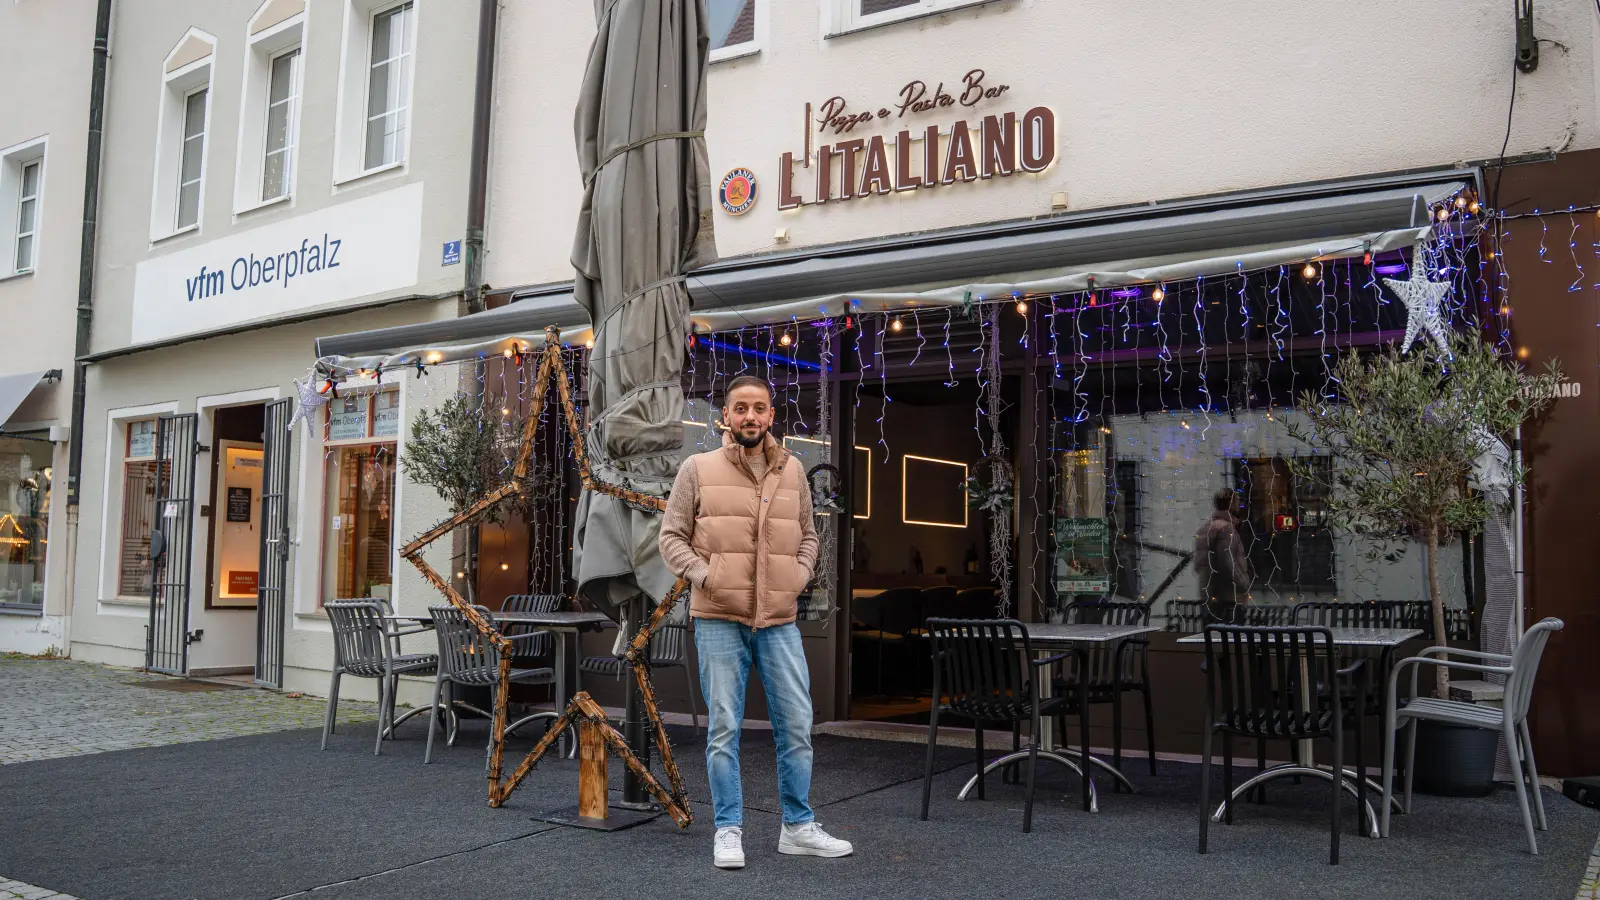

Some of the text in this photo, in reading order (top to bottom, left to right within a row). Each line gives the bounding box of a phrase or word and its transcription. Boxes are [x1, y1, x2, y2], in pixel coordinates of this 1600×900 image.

[816, 69, 1010, 135] Pizza e Pasta Bar
[777, 102, 1055, 211] L'ITALIANO
[721, 169, 756, 190] PAULANER
[448, 243, 455, 255] 2
[186, 233, 342, 302] vfm Oberpfalz
[331, 417, 342, 426] vfm
[374, 413, 387, 422] vfm
[1060, 522, 1105, 531] Weihnachten
[1076, 529, 1101, 538] Weiden
